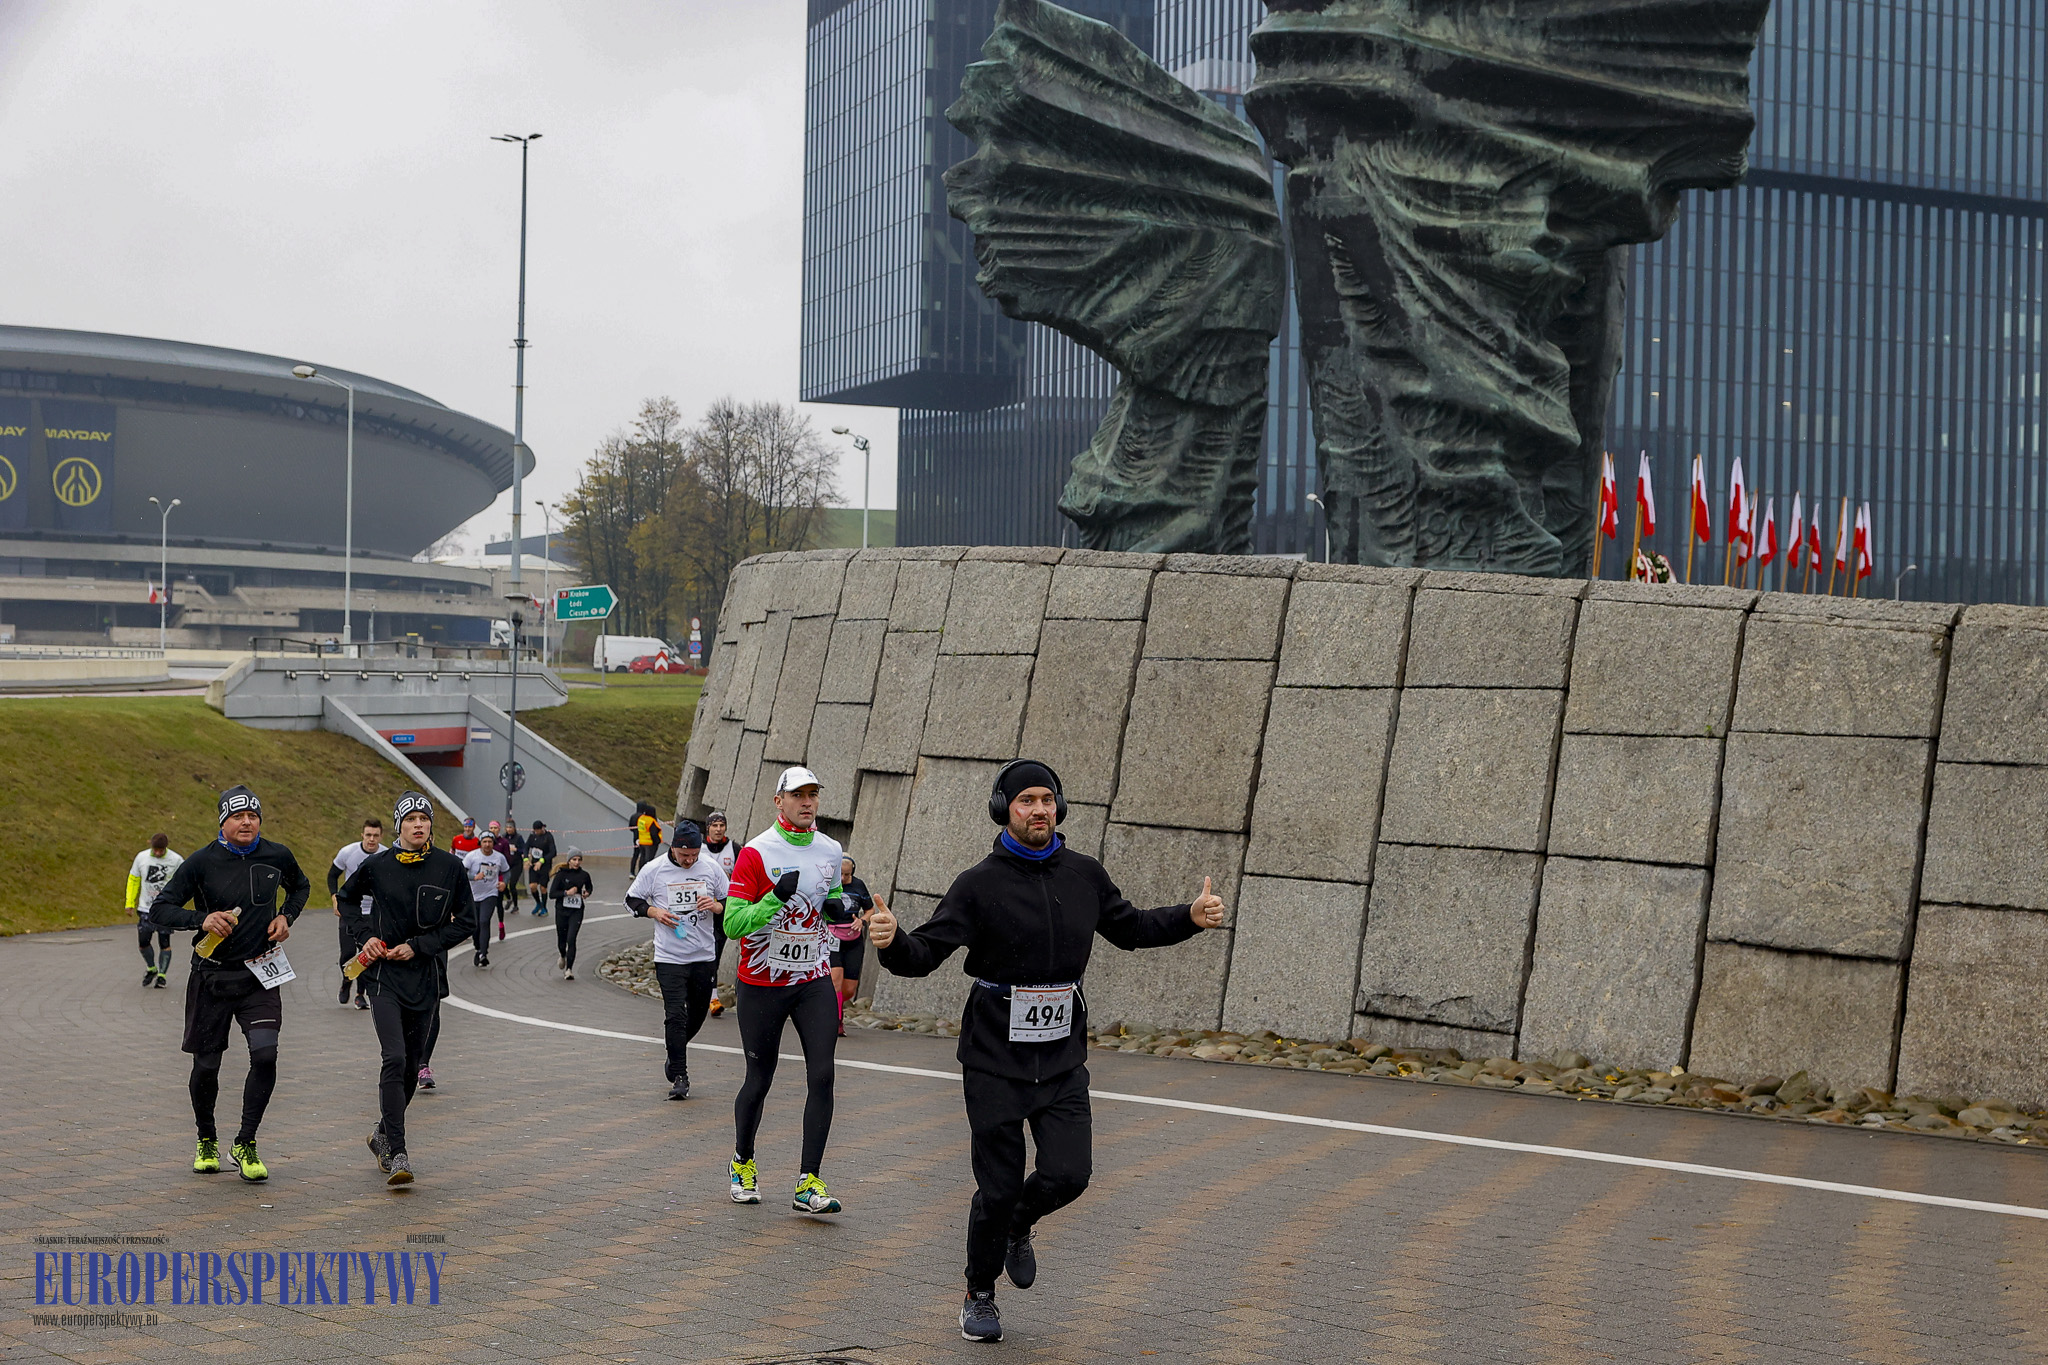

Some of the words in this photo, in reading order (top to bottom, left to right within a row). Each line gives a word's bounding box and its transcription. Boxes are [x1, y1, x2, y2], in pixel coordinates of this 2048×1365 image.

[44, 428, 112, 441] MAYDAY
[569, 609, 589, 617] Cieszyn
[675, 890, 699, 904] 351
[779, 943, 809, 960] 401
[262, 962, 279, 978] 80
[1025, 1004, 1065, 1027] 494
